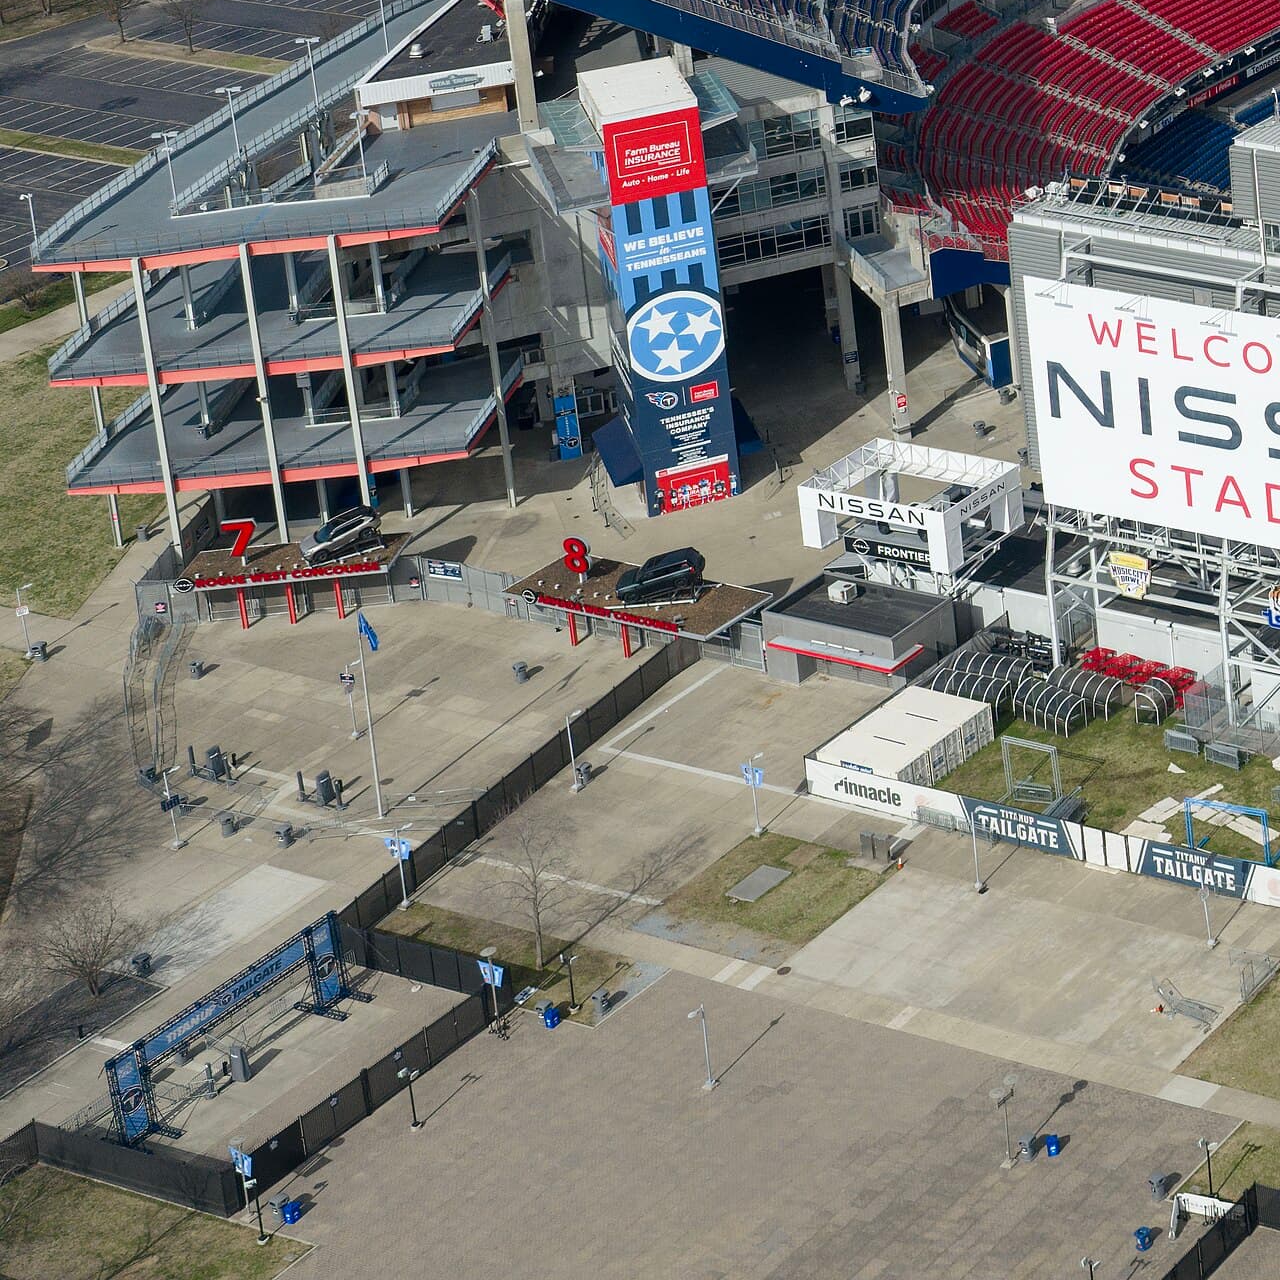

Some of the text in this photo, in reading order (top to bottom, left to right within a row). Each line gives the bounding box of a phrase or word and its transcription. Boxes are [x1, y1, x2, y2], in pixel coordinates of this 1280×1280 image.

[624, 140, 680, 157] Farm Bureau
[624, 148, 680, 165] INSURANCE
[622, 168, 690, 188] Auto Home Life
[624, 226, 704, 252] WE BELIEVE
[660, 246, 670, 254] in
[626, 247, 707, 272] TENNESSEANS
[660, 406, 714, 424] TENNESSEE'S
[666, 414, 711, 430] INSURANCE
[670, 421, 708, 434] COMPANY
[818, 493, 925, 526] NISSAN
[960, 481, 1005, 517] NISSAN
[220, 519, 256, 558] 7
[563, 537, 589, 574] 8
[195, 575, 247, 588] ROGUE
[249, 571, 287, 584] WEST
[291, 562, 380, 580] CONCOURSE
[1110, 564, 1150, 583] MUSIC CITY
[584, 605, 611, 618] WEST
[613, 611, 678, 632] CONCOURSE
[834, 776, 901, 807] Pinnacle
[978, 814, 1059, 849] TAILGATE
[1152, 855, 1236, 891] TAILGATE
[231, 959, 283, 999] TAILGATE
